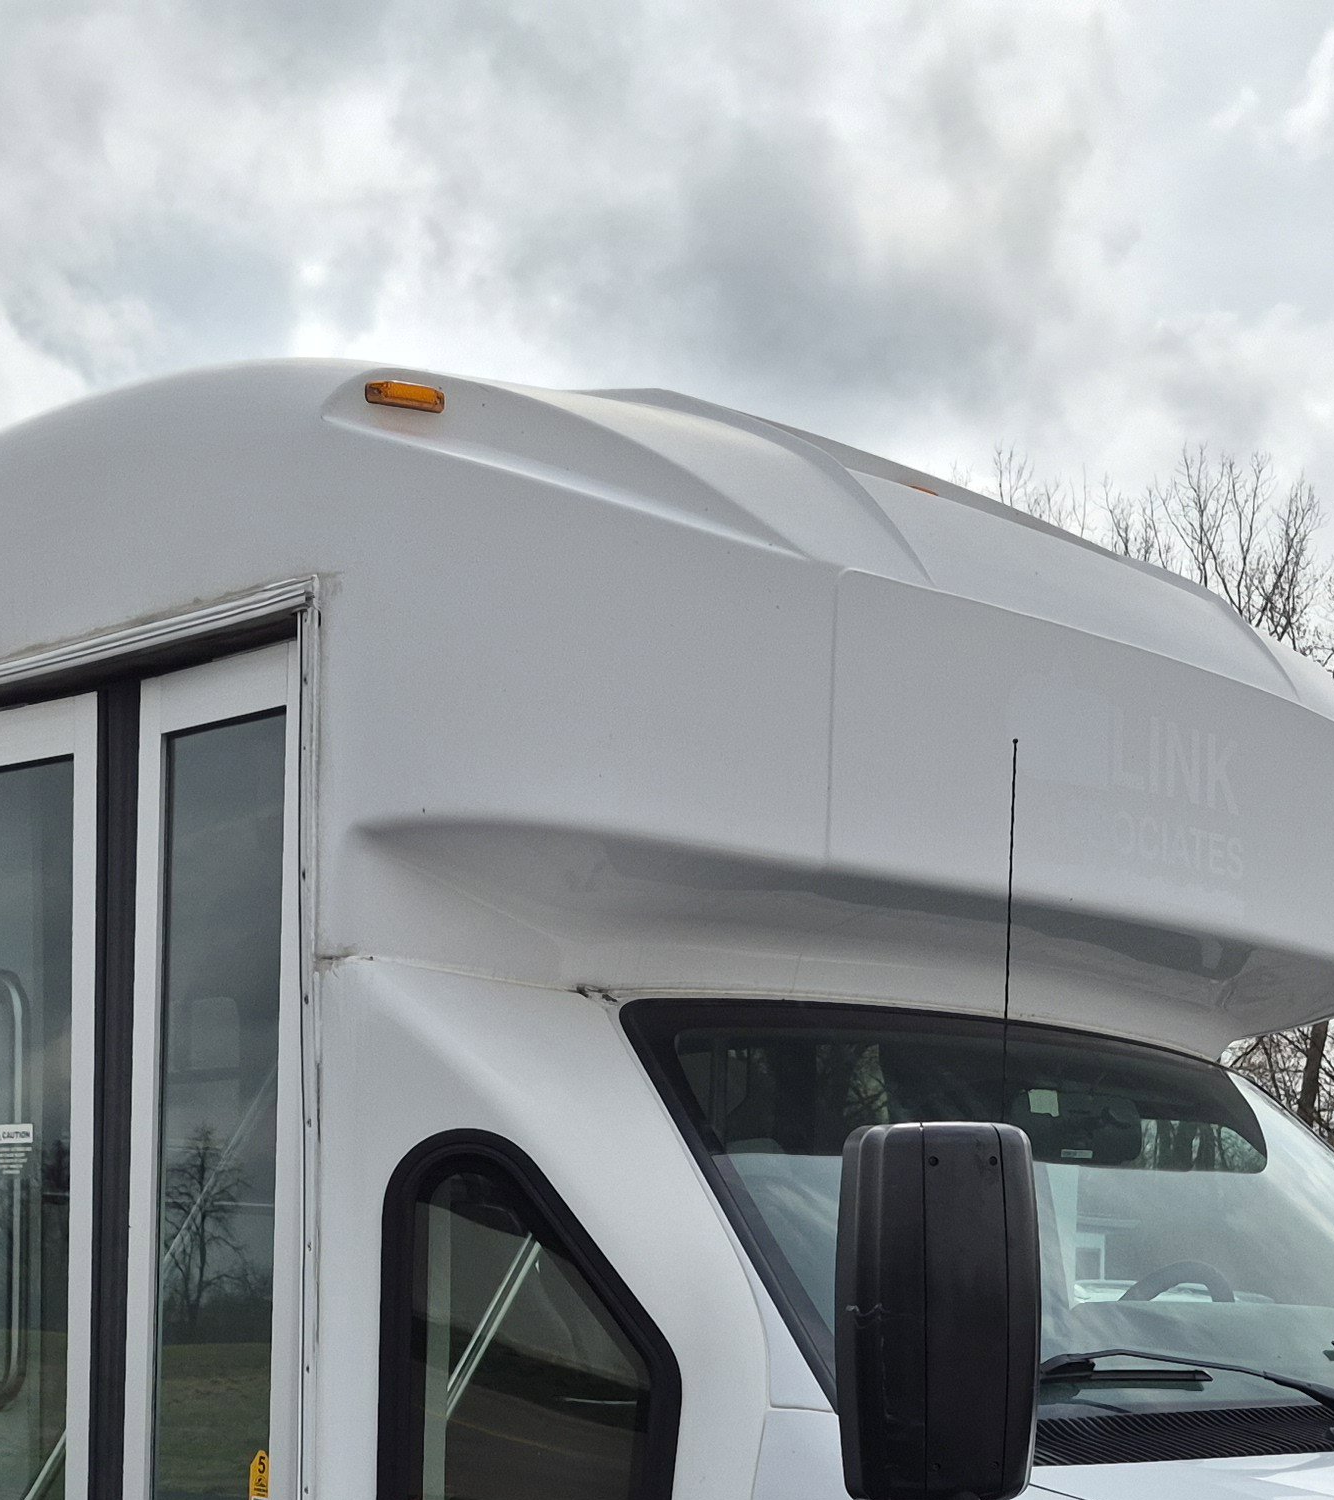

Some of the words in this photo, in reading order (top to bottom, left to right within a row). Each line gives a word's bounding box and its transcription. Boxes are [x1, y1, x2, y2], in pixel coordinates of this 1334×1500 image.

[1110, 703, 1240, 816] LINK
[2, 1131, 31, 1139] CAUTION
[257, 1455, 266, 1474] 5
